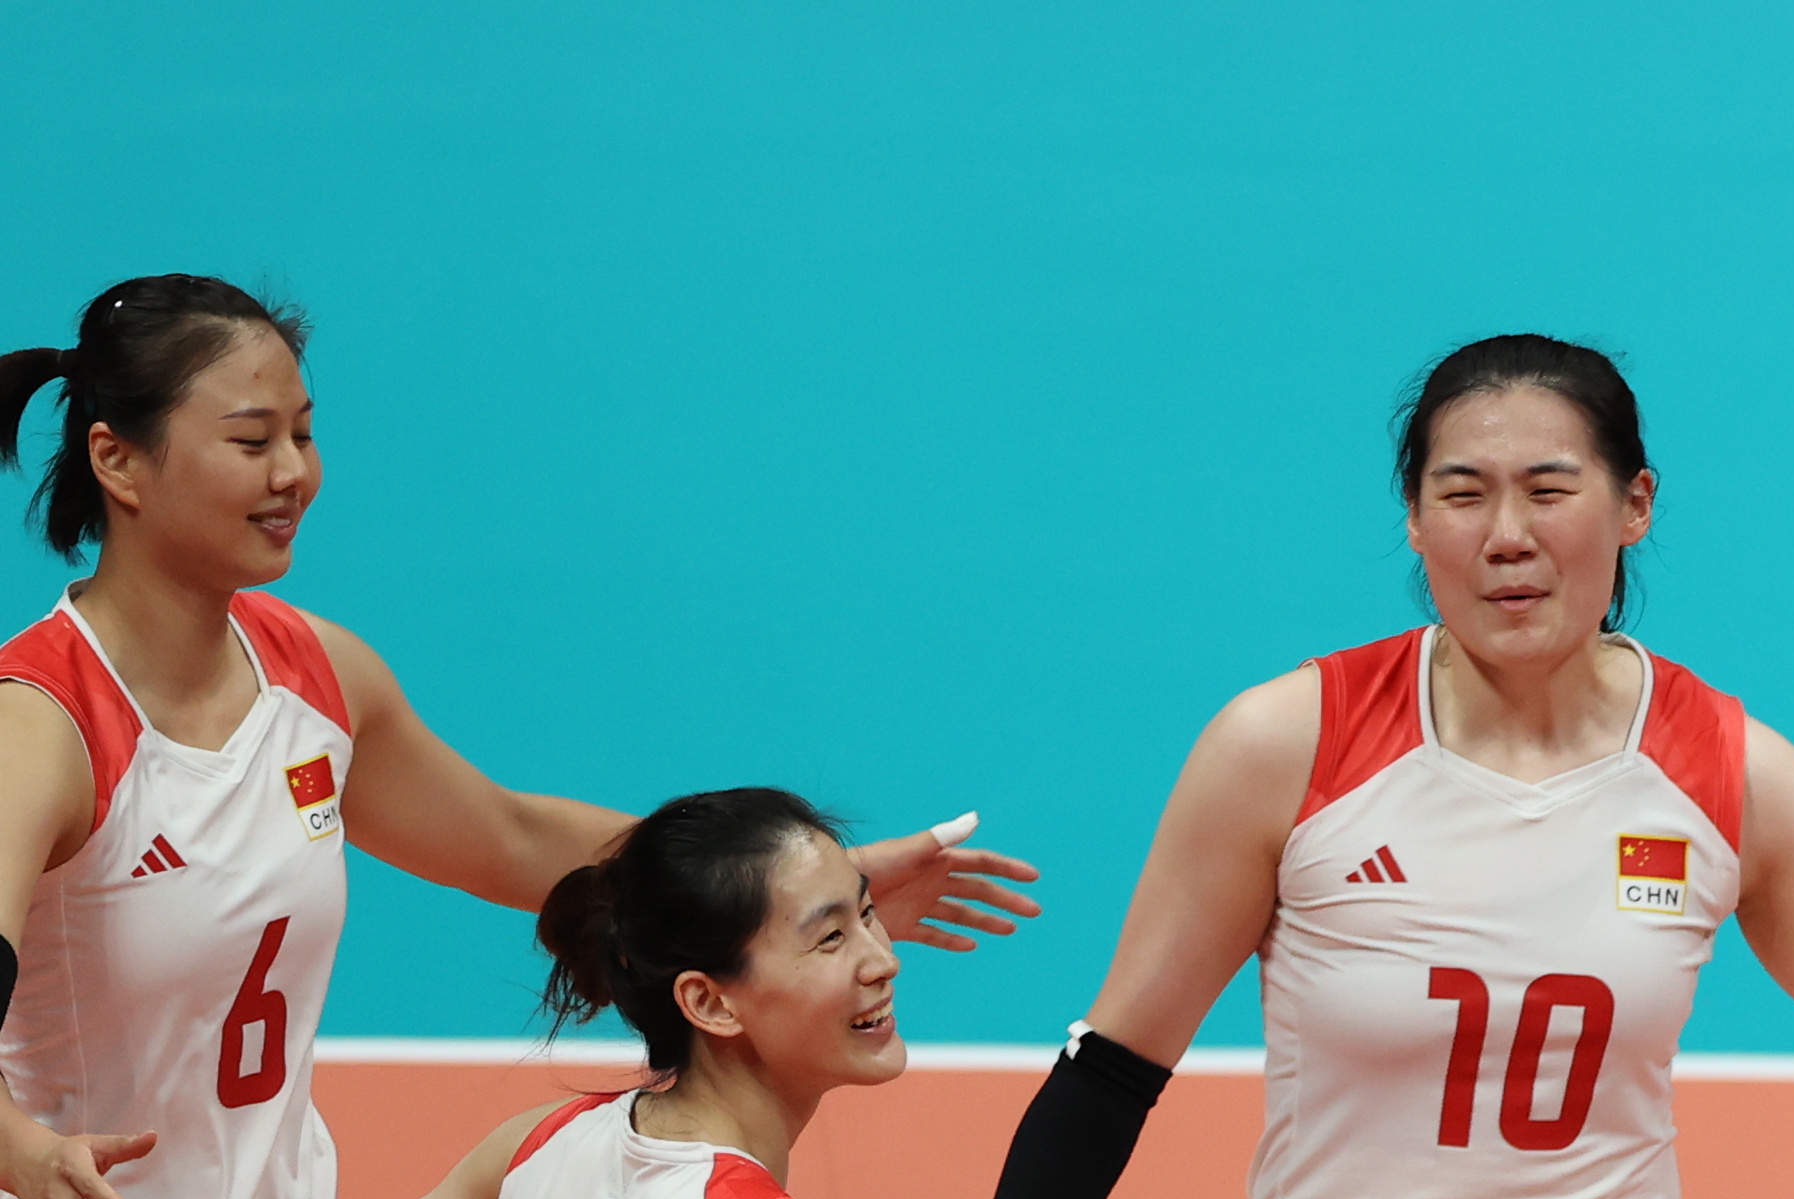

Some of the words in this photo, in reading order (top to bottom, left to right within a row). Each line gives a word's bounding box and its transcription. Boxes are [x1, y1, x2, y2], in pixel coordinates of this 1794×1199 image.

[1626, 885, 1679, 907] CHN
[216, 915, 291, 1109] 6
[1427, 966, 1615, 1152] 10
